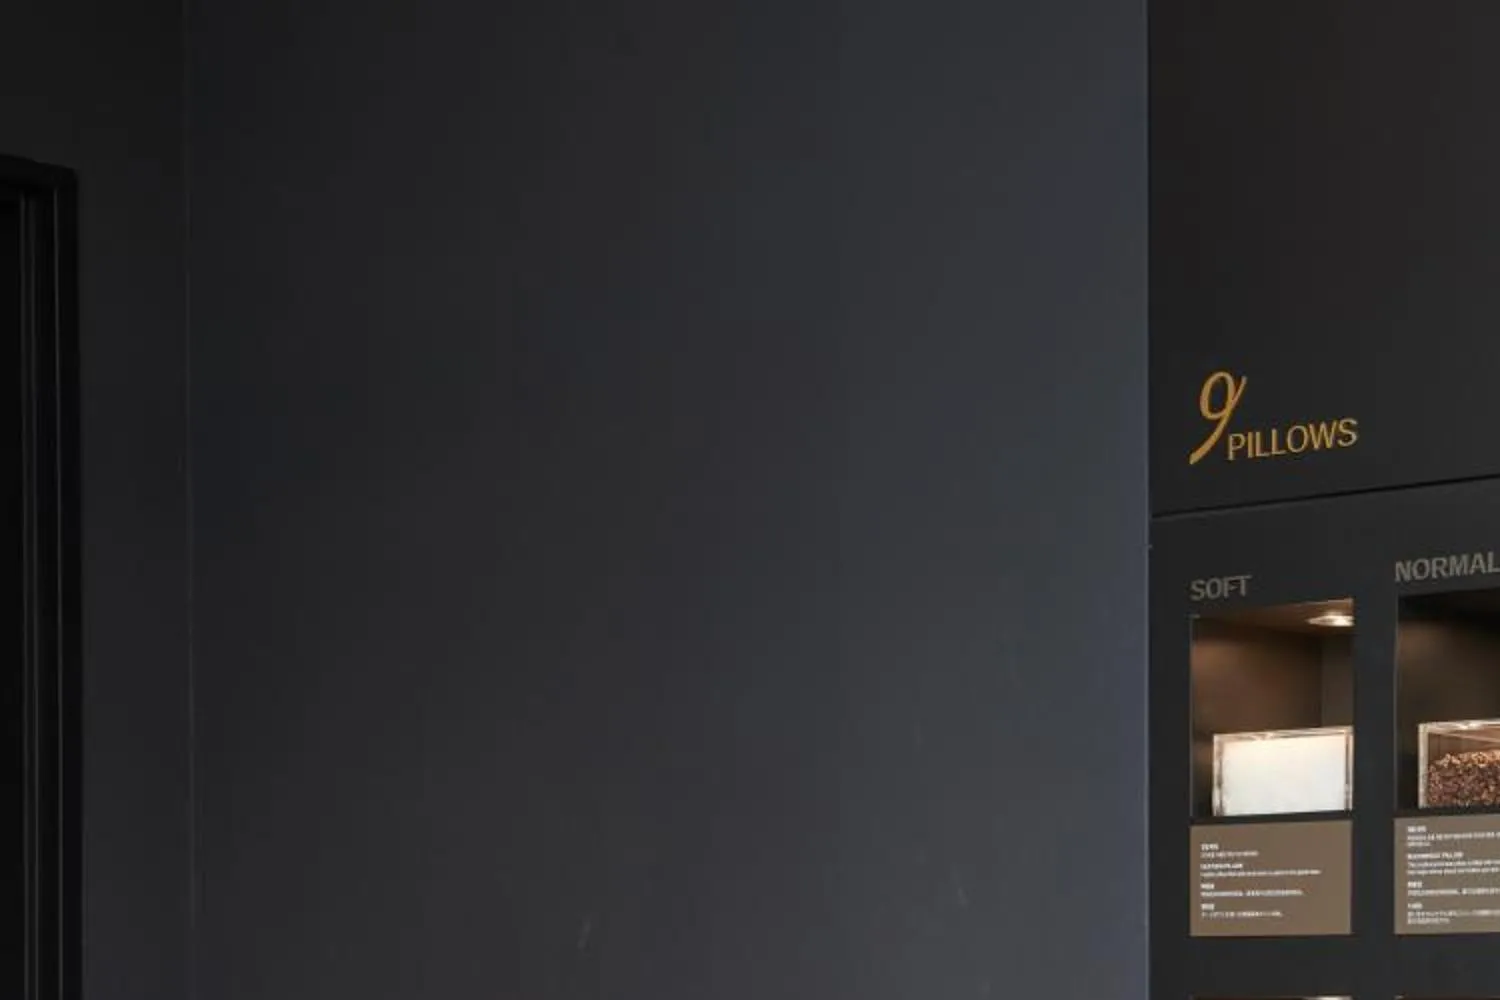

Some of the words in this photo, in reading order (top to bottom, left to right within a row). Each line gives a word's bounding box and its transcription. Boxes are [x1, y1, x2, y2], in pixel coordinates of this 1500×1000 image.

[1189, 371, 1247, 465] 9
[1228, 417, 1358, 461] PILLOWS
[1190, 574, 1252, 601] SOFT
